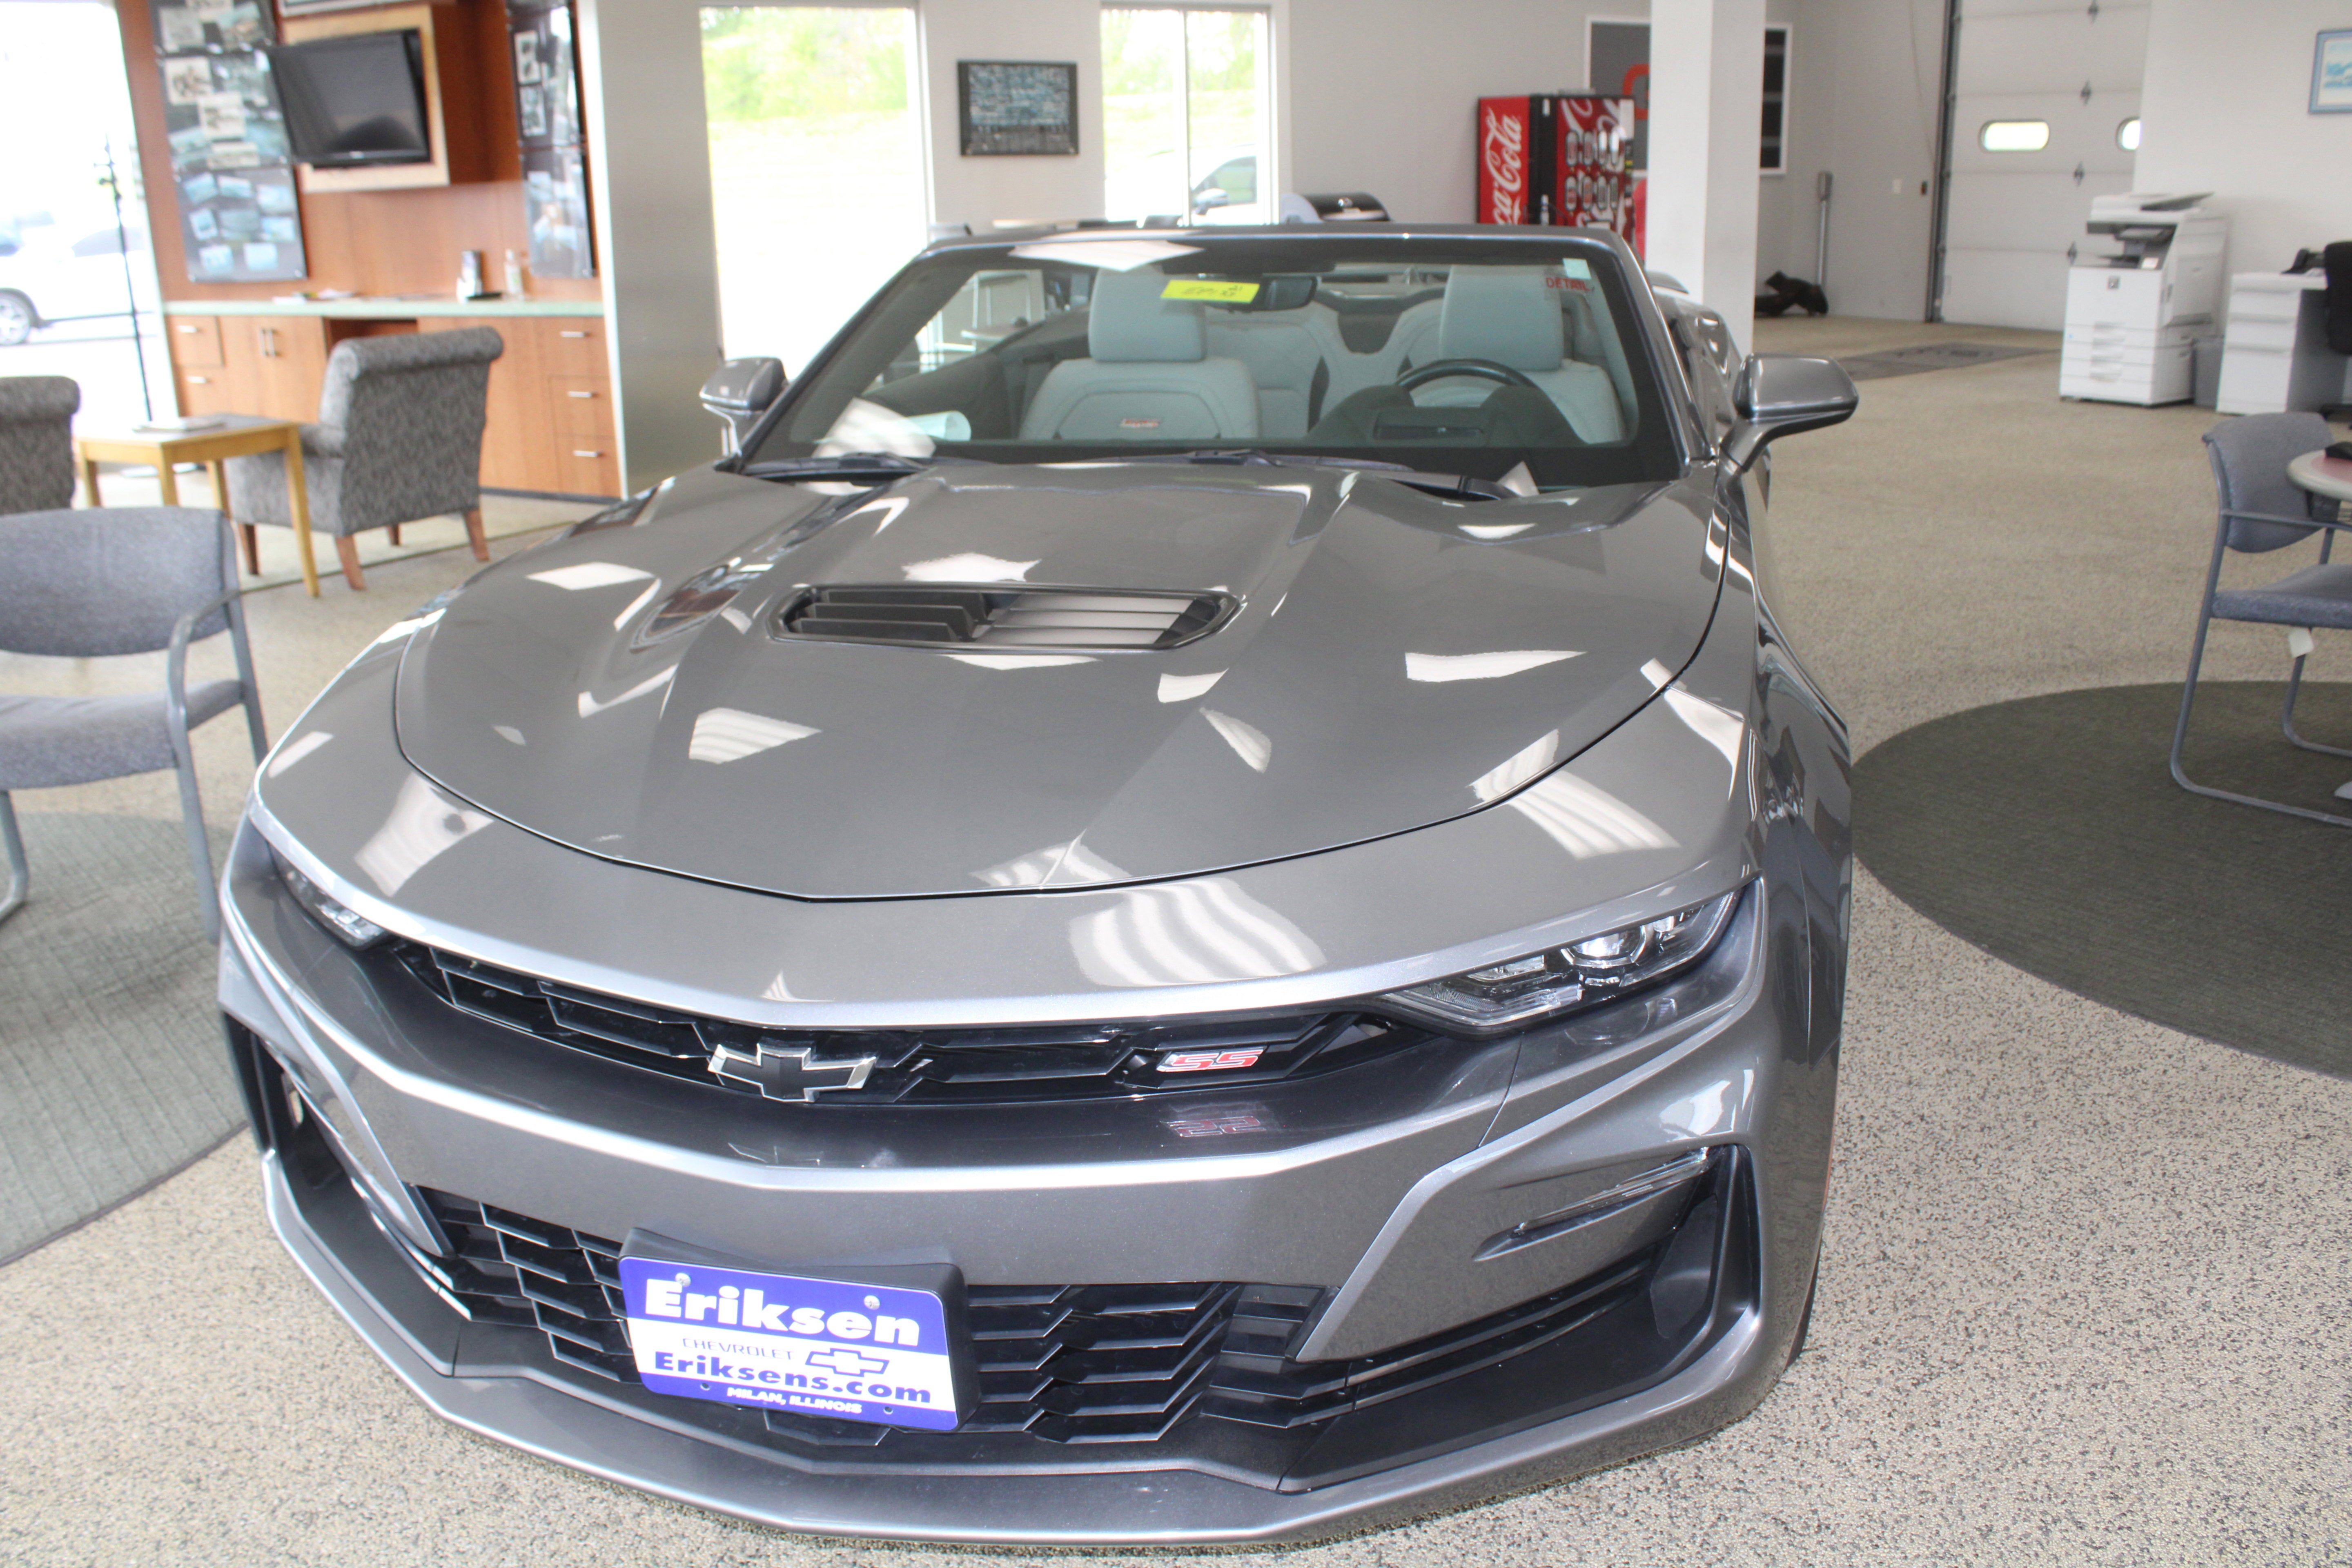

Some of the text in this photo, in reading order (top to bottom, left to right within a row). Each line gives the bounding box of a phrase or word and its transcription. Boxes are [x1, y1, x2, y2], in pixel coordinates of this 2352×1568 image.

[1485, 106, 1523, 224] ca-Cola
[1156, 1049, 1265, 1072] SS
[645, 1278, 920, 1346] Eriksen
[683, 1338, 795, 1361] CHEVROLET
[655, 1351, 931, 1403] Eriksens.com
[727, 1387, 862, 1414] MILAN, ILLINOIS
